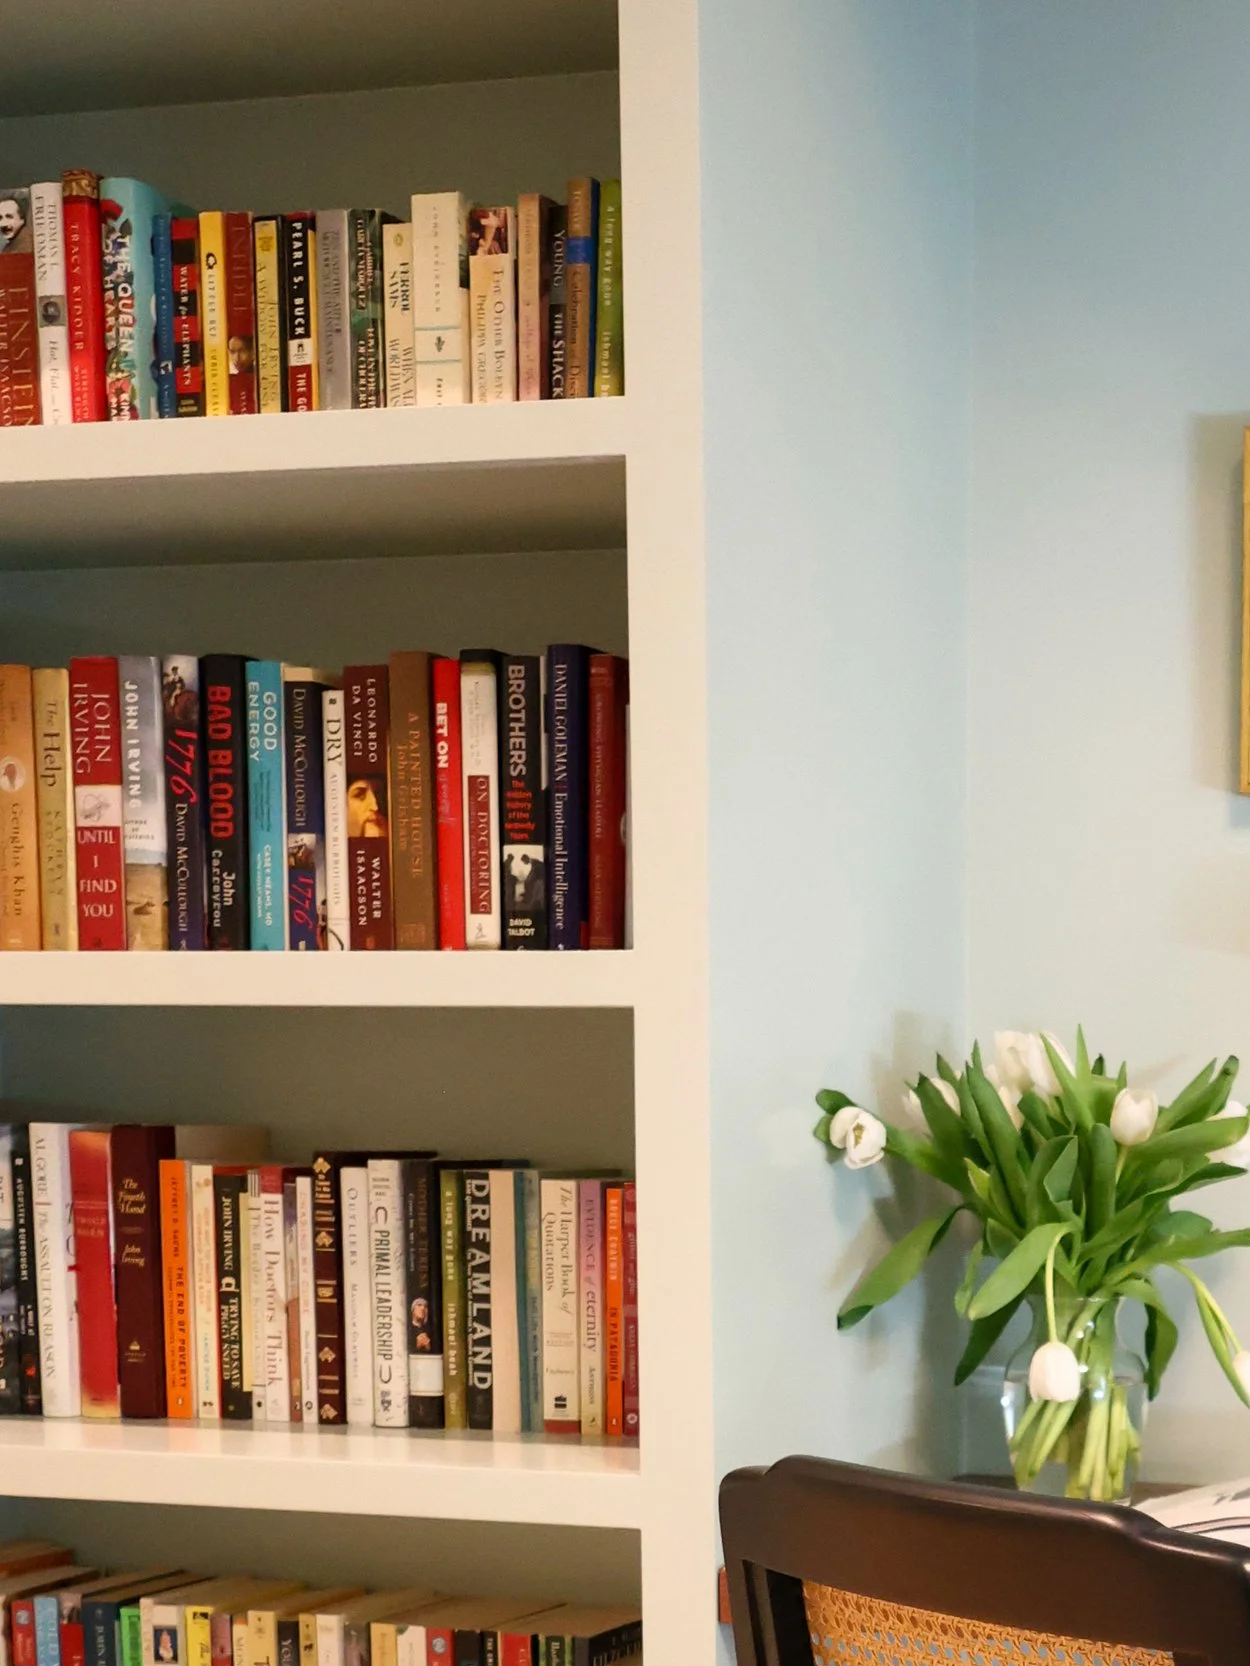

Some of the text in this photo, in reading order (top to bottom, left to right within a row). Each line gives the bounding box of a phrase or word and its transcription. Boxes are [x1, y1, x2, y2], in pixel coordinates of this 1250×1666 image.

[34, 196, 47, 281] FRIEDMAN
[553, 230, 565, 287] YOUNG
[603, 250, 614, 272] way
[70, 224, 84, 351] TRACY KIDDER
[104, 277, 118, 351] HEARTS
[118, 235, 134, 353] THE QUEEN
[292, 222, 305, 335] PEARL S. BUCK
[389, 270, 399, 309] SAMS
[180, 266, 191, 386] WATER ELEPHANTS
[268, 300, 280, 402] JOHN IRVING
[493, 268, 506, 400] THE OTHER BOLEYN
[296, 373, 307, 393] THE
[553, 339, 565, 398] SHACK
[73, 683, 91, 773] IRVING
[92, 693, 112, 762] JOHN
[124, 680, 139, 730] JOHN
[247, 681, 260, 762] ENERGY
[262, 692, 277, 751] GOOD
[293, 688, 307, 729] DAVID
[326, 718, 343, 766] DRY
[351, 685, 362, 757] DA VINCI
[367, 678, 378, 763] LEONARDO
[436, 702, 449, 768] BET ON
[506, 664, 526, 777] BROTHERS
[554, 664, 569, 782] DANIEL GOLEMAN
[40, 701, 62, 787] The Help
[127, 738, 141, 808] IRVING
[166, 728, 198, 806] 1776
[208, 686, 235, 839] BAD BLOOD
[176, 803, 187, 842] DAVID
[396, 744, 409, 852] John Grisham
[407, 712, 423, 878] A PAINTED HOUSE
[476, 777, 489, 802] ON
[9, 802, 25, 916] Genghis Khan
[77, 829, 116, 845] UNTIL
[477, 812, 492, 913] DOCTORING
[553, 792, 570, 929] Emotional Intelligence
[79, 879, 117, 893] FIND
[82, 904, 114, 918] YOU
[222, 871, 236, 906] John
[288, 875, 314, 932] 1776
[356, 849, 367, 926] ISAACSON
[371, 857, 382, 919] WALTER
[509, 918, 532, 926] DAVID
[35, 1156, 48, 1195] GORE
[222, 1196, 233, 1271] JOHN IRVING
[346, 1187, 359, 1267] OUTLIERS
[445, 1230, 454, 1251] way
[543, 1211, 557, 1292] Quotations
[557, 1186, 574, 1315] The Harper Book of
[263, 1200, 283, 1387] How Doctors Think
[374, 1230, 393, 1361] PRIMAL LEADERSHIP
[470, 1179, 492, 1390] DREAMLAND
[584, 1199, 599, 1352] EVIDENCE eternity
[44, 1323, 56, 1379] REASON
[176, 1266, 187, 1388] THE END OF POVERTY
[220, 1304, 231, 1380] PIGGY SNEED
[228, 1298, 240, 1388] TRYING TO SAVE
[610, 1322, 619, 1382] PATAGONIA
[94, 1625, 105, 1658] JOHN
